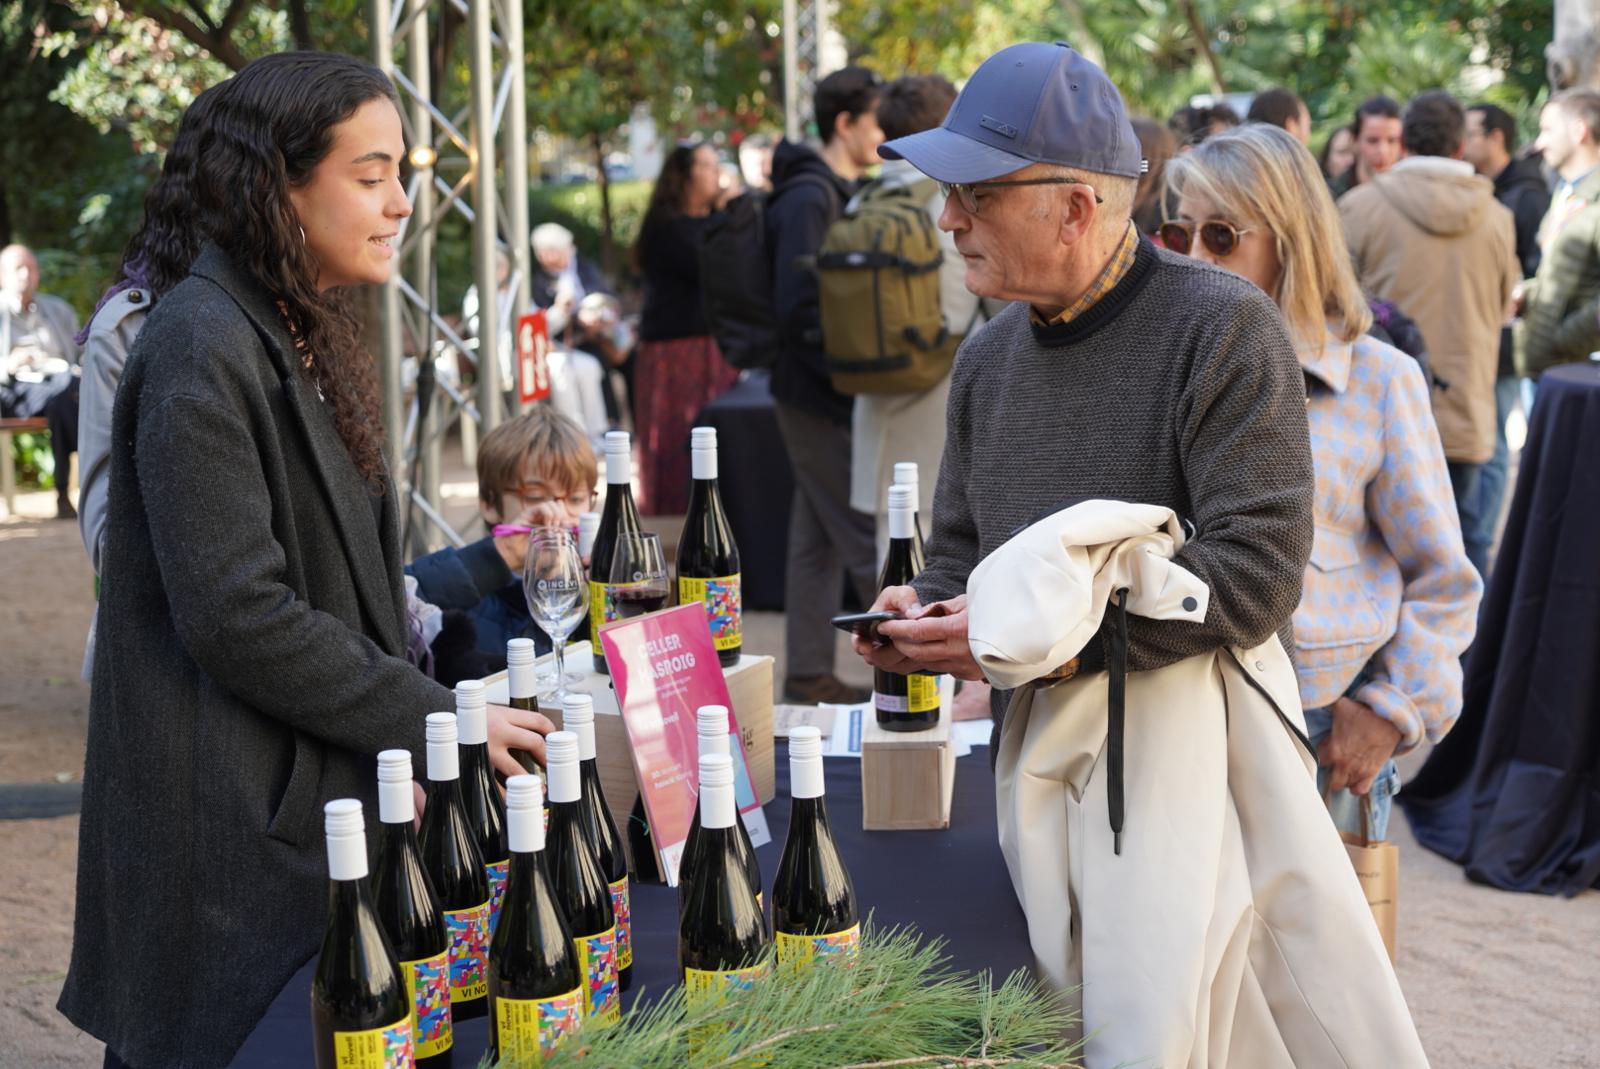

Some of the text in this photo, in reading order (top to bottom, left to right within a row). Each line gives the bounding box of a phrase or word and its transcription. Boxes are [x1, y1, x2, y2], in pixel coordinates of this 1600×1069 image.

[638, 633, 682, 658] CELLER
[461, 986, 472, 998] VI
[435, 1040, 444, 1051] VI
